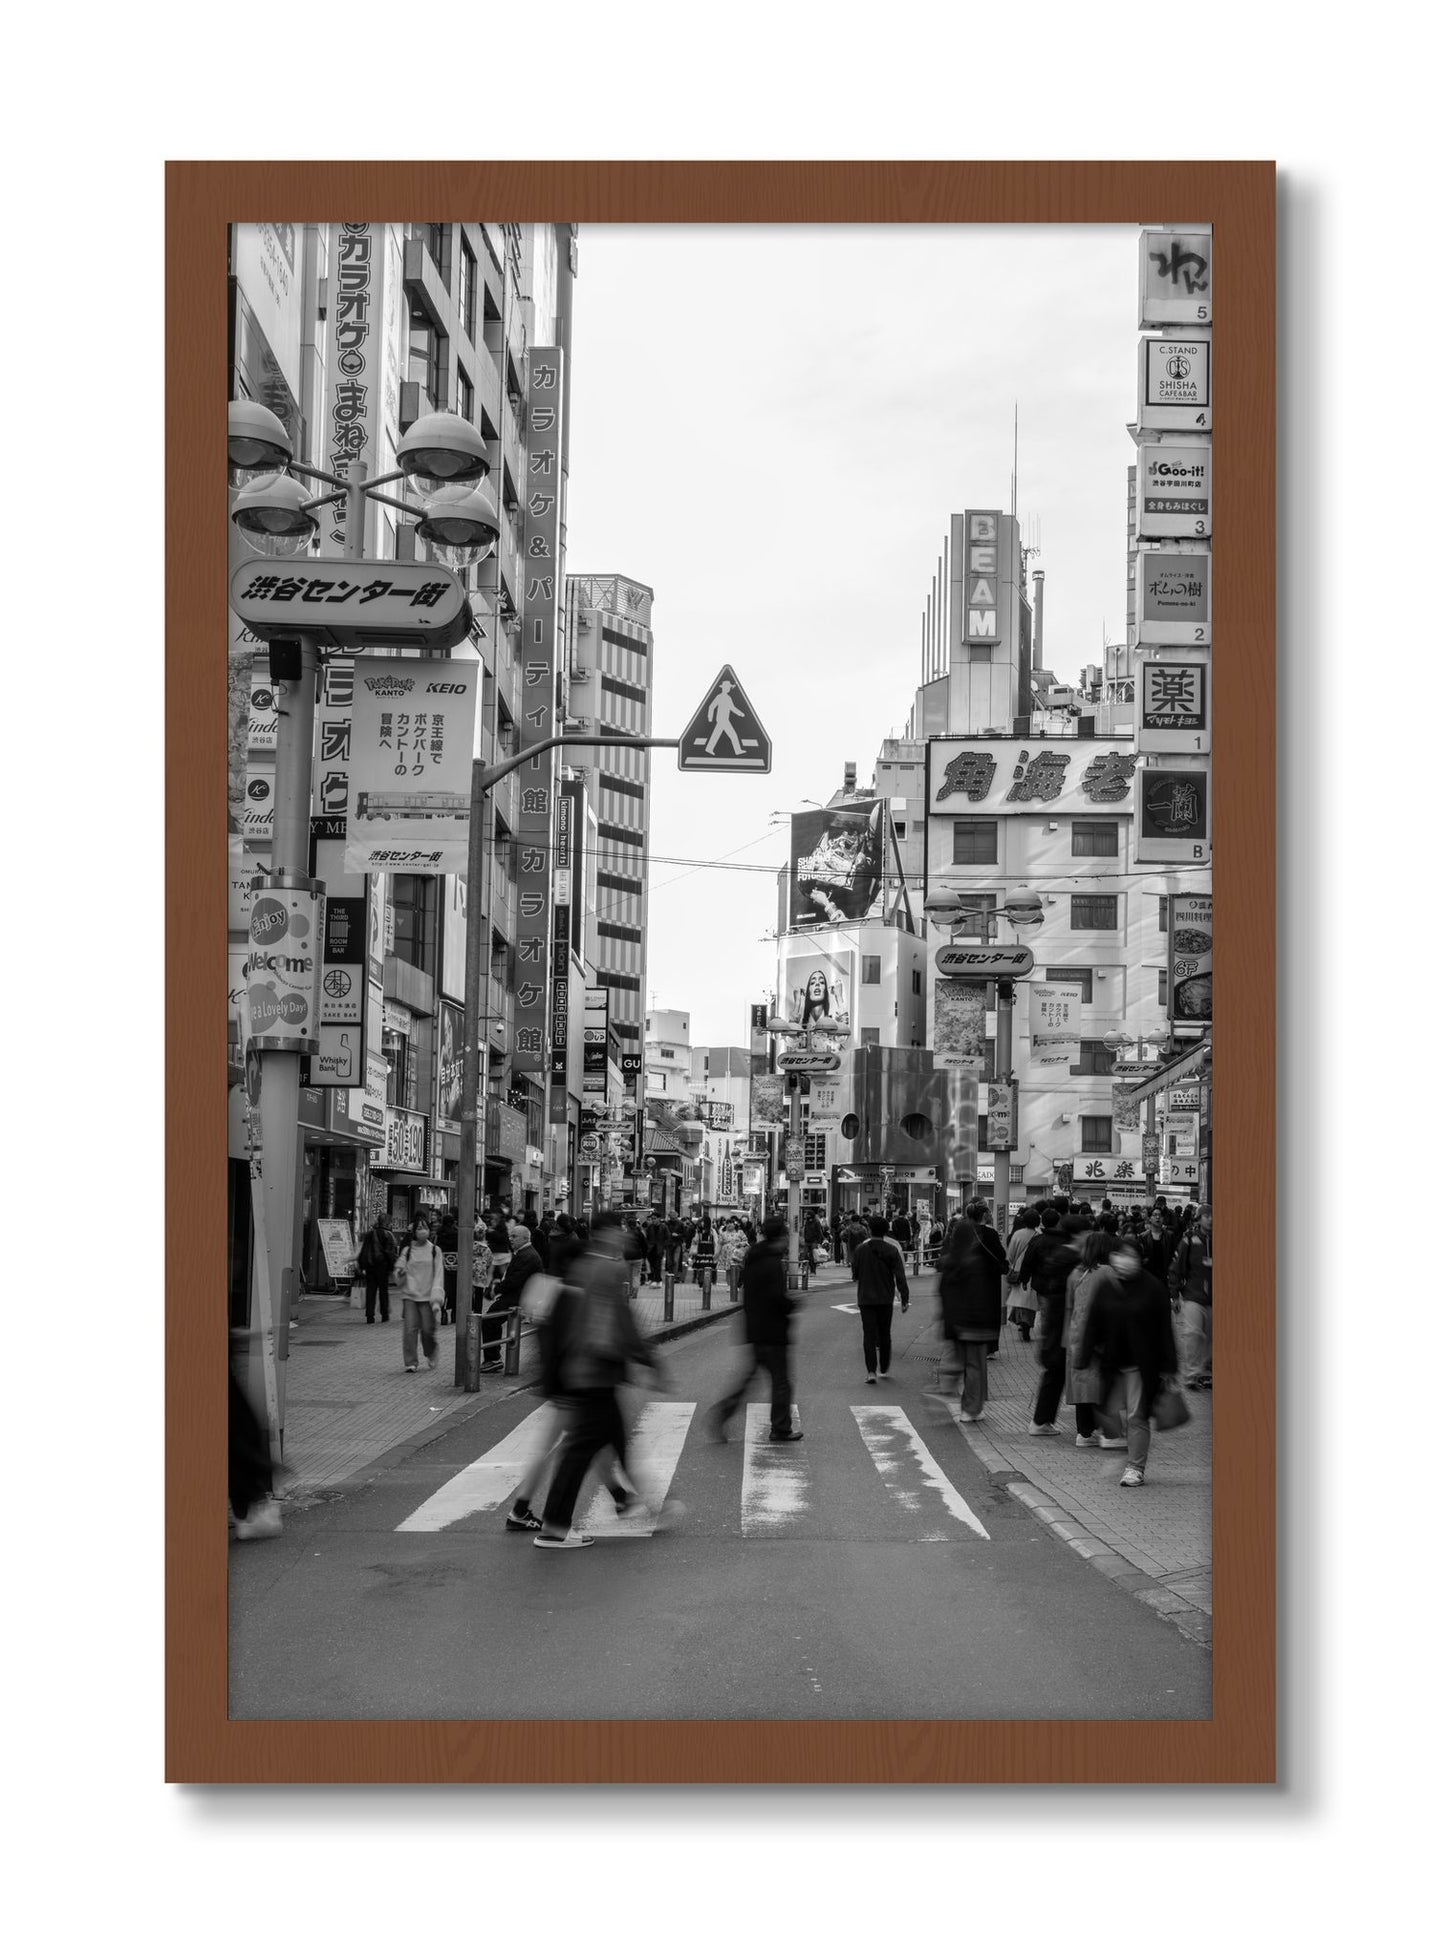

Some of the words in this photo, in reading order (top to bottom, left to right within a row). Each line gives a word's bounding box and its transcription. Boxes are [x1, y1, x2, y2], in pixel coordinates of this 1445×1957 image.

[336, 234, 372, 351] カラオケ
[1197, 306, 1207, 319] 5
[1159, 346, 1198, 354] C.STAND
[1159, 381, 1197, 390] SHISHA
[1158, 463, 1204, 477] Goo-it!
[1148, 501, 1206, 511] 全身もみほぐし
[1195, 520, 1205, 534] 3
[969, 513, 997, 637] BEAM
[241, 575, 451, 607] 渋谷センター街
[1194, 628, 1205, 641] 2
[375, 689, 405, 697] KANTO
[426, 682, 467, 694] KEIO
[1151, 669, 1195, 712] 薬
[378, 713, 393, 749] 冒険へ
[394, 713, 410, 776] カントーの
[430, 714, 445, 764] 京王線で
[1194, 737, 1201, 749] 1
[936, 750, 1139, 801] 角海老
[559, 801, 568, 832] kimono
[367, 850, 444, 861] 渋谷センター街
[558, 834, 568, 864] hearts
[1193, 845, 1203, 858] B
[252, 909, 286, 938] Enjoy
[516, 848, 546, 1053] カラオケ館
[248, 952, 313, 974] Welcome
[941, 952, 1029, 965] 渋谷センター街
[1174, 961, 1199, 977] 6F
[290, 1001, 306, 1013] Day!
[320, 1056, 348, 1066] Whisky
[623, 1059, 640, 1069] GU
